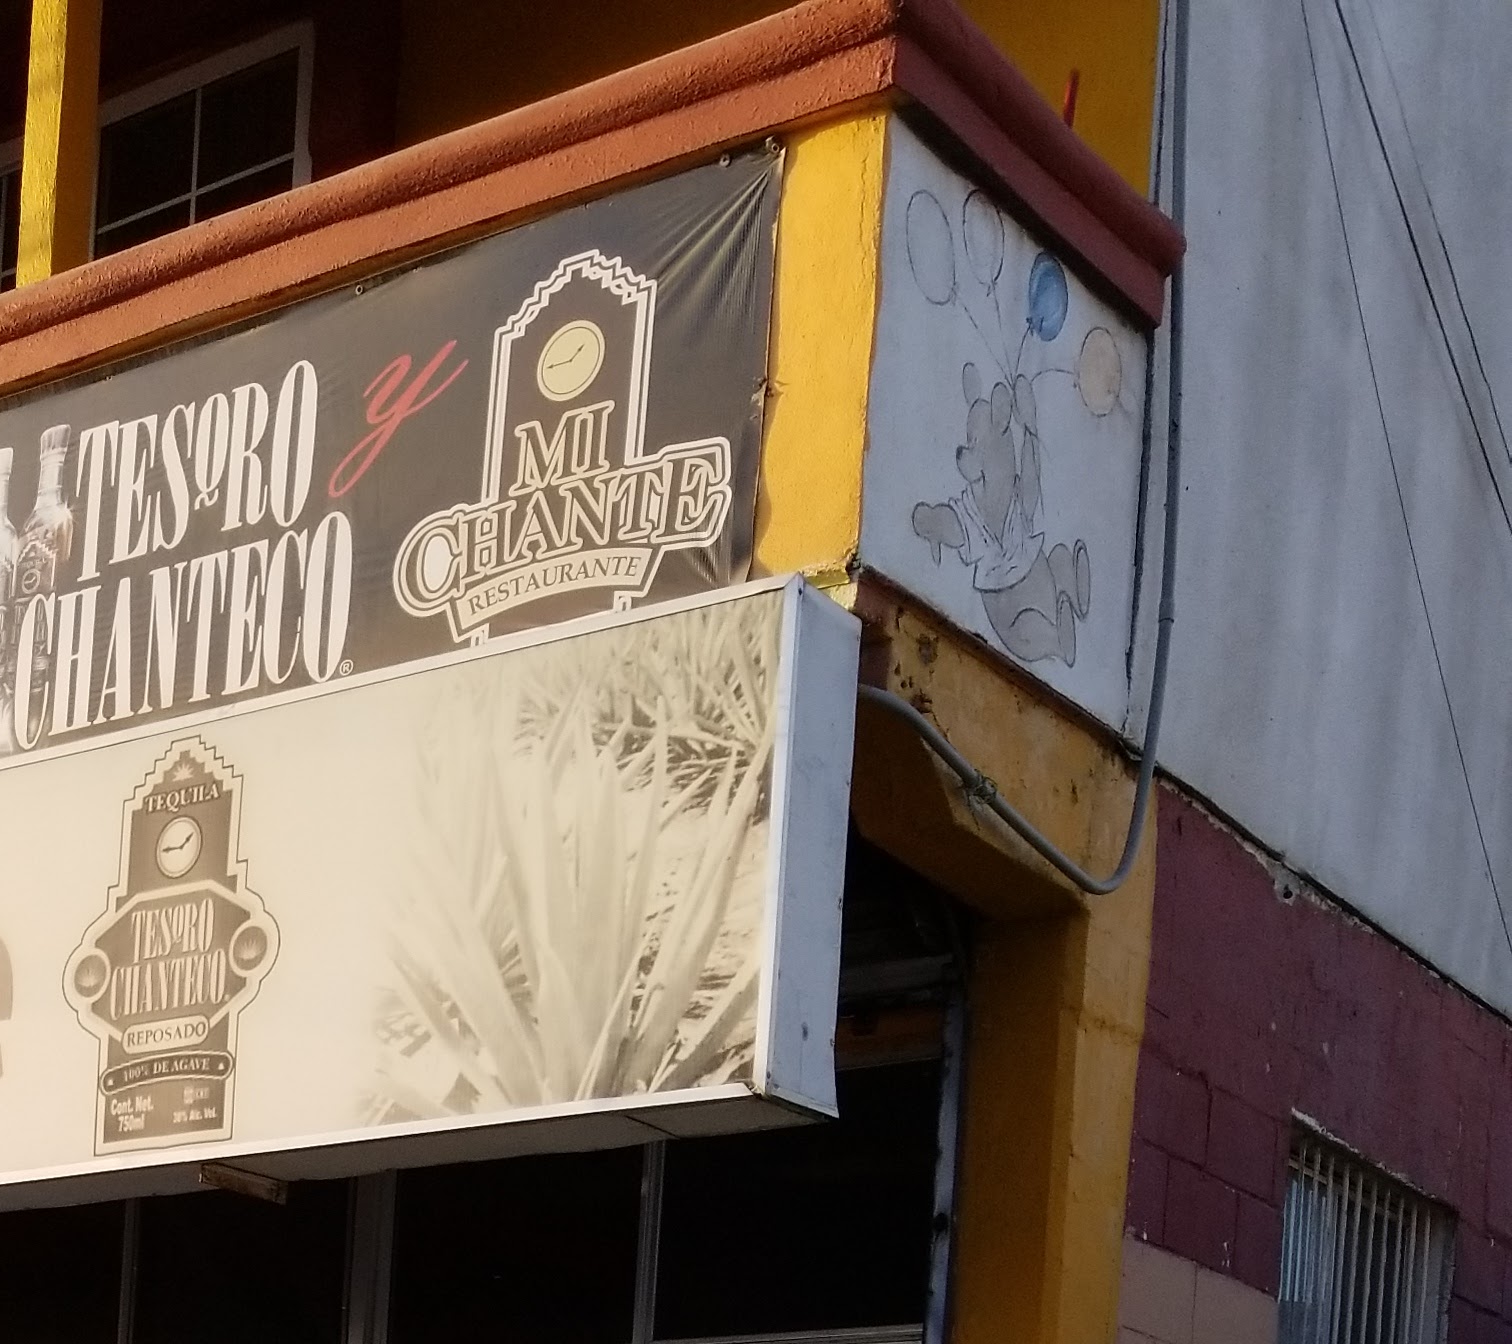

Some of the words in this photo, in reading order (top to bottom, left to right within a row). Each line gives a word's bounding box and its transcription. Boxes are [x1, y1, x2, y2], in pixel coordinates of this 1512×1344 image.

[74, 359, 319, 583] TESORO
[514, 400, 615, 498] MI
[400, 446, 726, 612] CHANTE
[467, 554, 643, 617] RESTAURANTE
[144, 783, 221, 815] TEQUILA
[130, 898, 216, 964] TESORO
[126, 1022, 207, 1048] REPOSADO
[153, 1061, 170, 1075] DE
[171, 1057, 210, 1073] AGAVE
